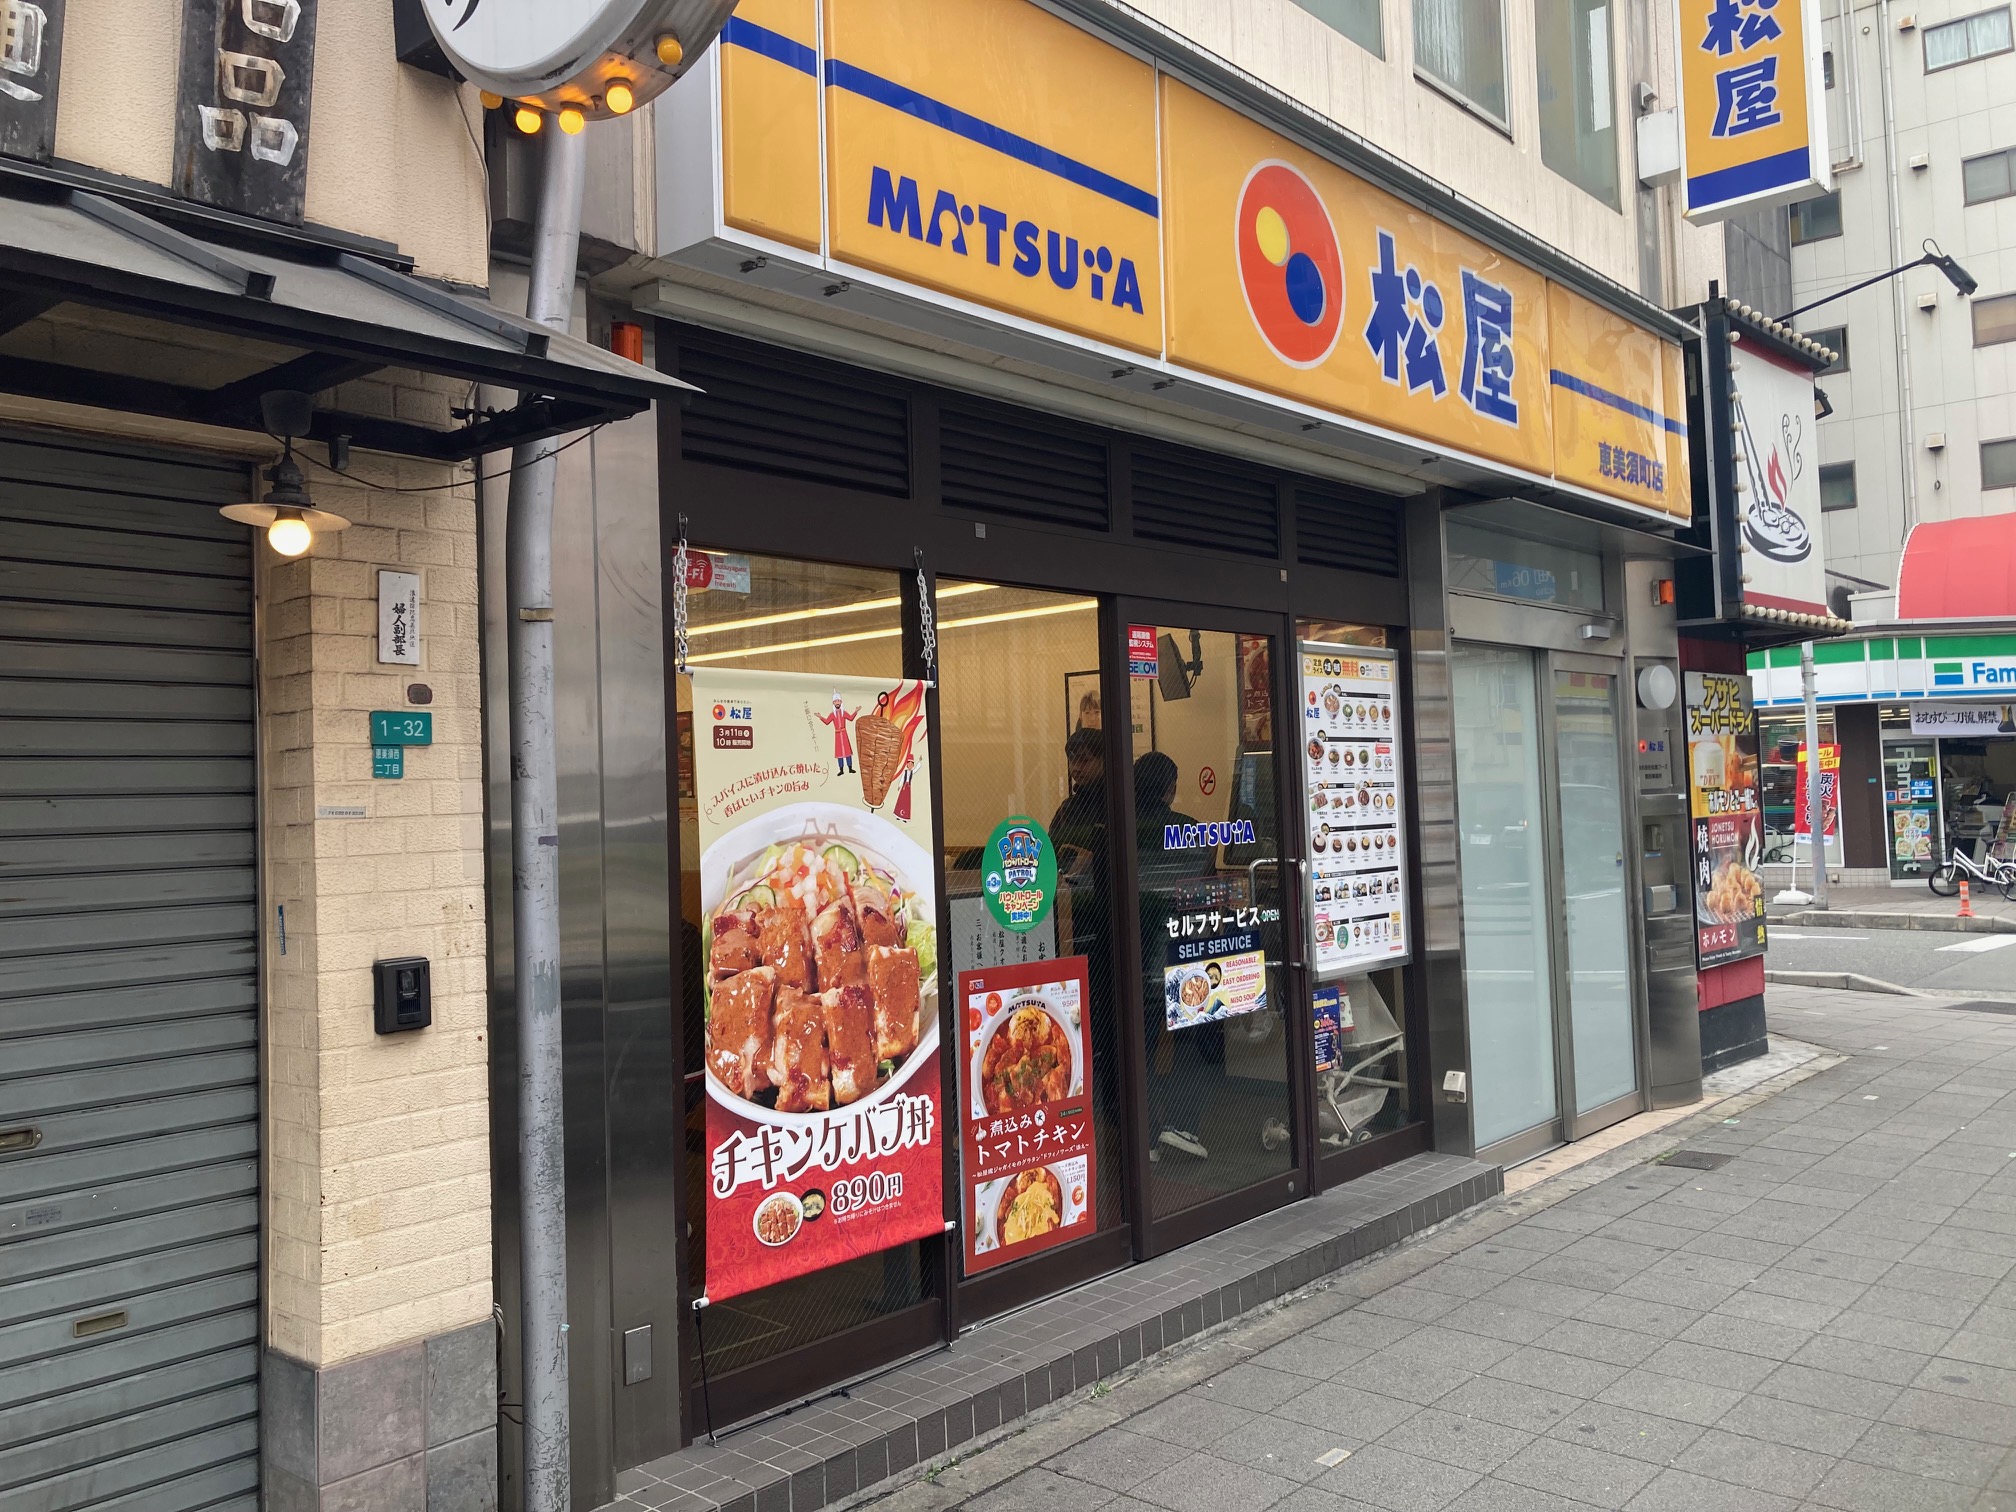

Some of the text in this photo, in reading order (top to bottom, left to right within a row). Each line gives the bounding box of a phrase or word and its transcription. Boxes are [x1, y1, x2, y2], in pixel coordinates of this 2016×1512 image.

[1700, 0, 1783, 139] 松屋
[867, 165, 1144, 316] MATSUYA
[1364, 227, 1519, 427] 松屋
[1597, 440, 1665, 494] 恵美須町店
[392, 602, 407, 656] 婦人副部長
[1702, 676, 1740, 710] アサヒ
[730, 706, 752, 720] 松屋
[1306, 707, 1320, 719] 松屋
[1691, 708, 1753, 735] スーパードライ
[1915, 710, 2000, 724] おむすび二刀流、解禁。
[381, 719, 425, 737] 1-32
[375, 764, 399, 775] 二丁目
[711, 763, 821, 807] スパイスに漬け込んで焼いた
[1820, 772, 1834, 798] 炭火
[724, 781, 810, 817] 香ばしいチキンの旨み
[1163, 820, 1256, 850] MATSUYA
[1711, 821, 1735, 833] JONETSU
[1711, 832, 1740, 845] HORUMON
[997, 836, 1043, 860] PAW
[1696, 824, 1711, 886] 焼肉
[1008, 868, 1034, 879] PATROL
[1004, 902, 1039, 912] キャンペーン
[1262, 909, 1280, 922] OPEN
[1166, 906, 1261, 938] セルフサービス
[1178, 934, 1252, 959] SELF SERVICE
[1702, 929, 1736, 948] ホルモン
[1226, 957, 1257, 968] REASONABLE
[1222, 972, 1260, 986] EASY ORDERING
[1008, 1000, 1046, 1014] MATSUYA
[1230, 993, 1256, 1004] MISO SOUP
[990, 1113, 1033, 1138] 煮込み
[714, 1097, 932, 1195] チキンケバブ丼
[977, 1121, 1086, 1166] トマトチキン
[831, 1173, 903, 1213] 890円
